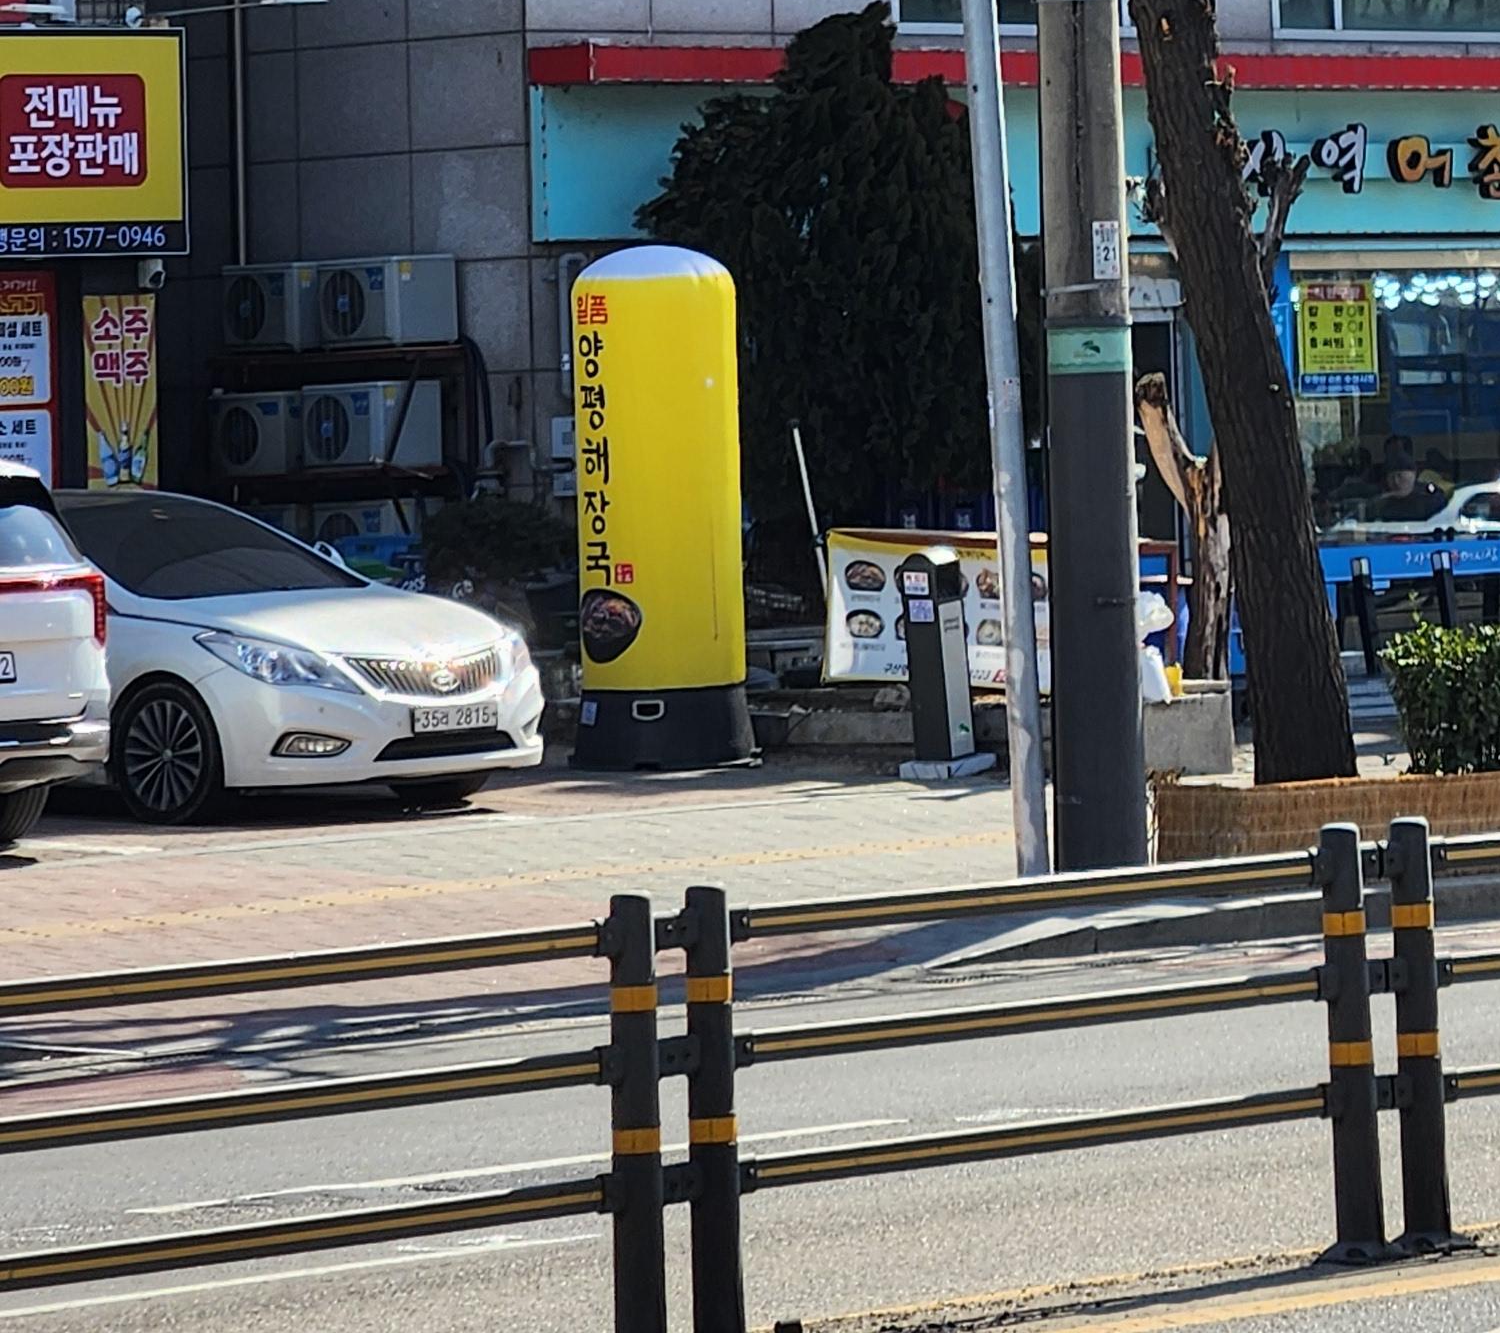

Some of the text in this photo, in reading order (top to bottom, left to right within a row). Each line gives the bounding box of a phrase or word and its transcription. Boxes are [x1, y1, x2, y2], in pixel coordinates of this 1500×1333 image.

[23, 85, 123, 129] 전메뉴
[8, 132, 140, 178] 포장판매
[62, 224, 166, 250] 1577-0946
[576, 293, 609, 326] 일품
[578, 330, 612, 587] 양평해장국
[455, 706, 490, 727] 2815
